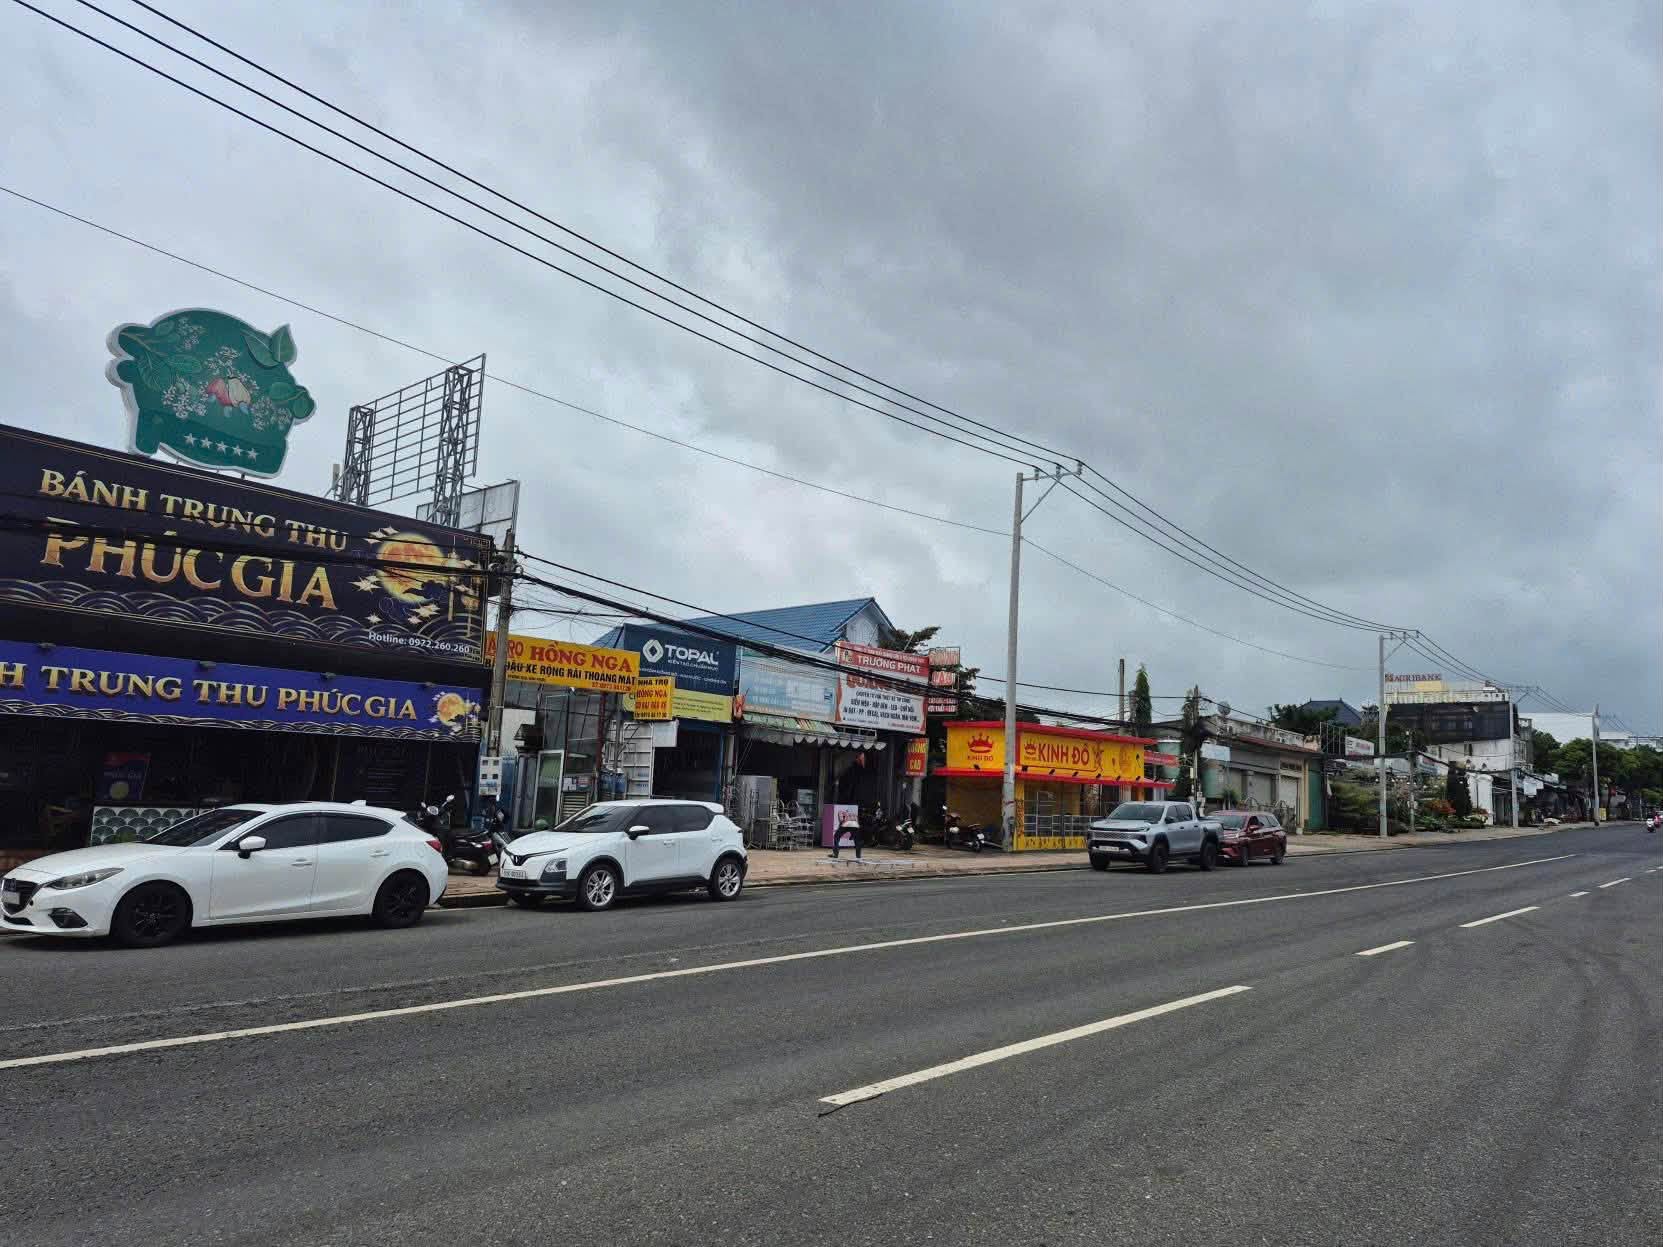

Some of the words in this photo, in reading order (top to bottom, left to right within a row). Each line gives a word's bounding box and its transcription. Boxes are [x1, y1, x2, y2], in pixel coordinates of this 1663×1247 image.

[39, 468, 150, 512] BÁNH
[160, 493, 276, 537] TRUNG
[284, 519, 349, 551] THU
[231, 554, 337, 610] GIA
[368, 631, 407, 645] Hotline:
[526, 663, 537, 674] XE
[530, 640, 587, 667] HỒNG
[591, 653, 633, 673] NGA
[665, 644, 719, 666] TOPAL
[41, 665, 183, 700] TRUNG
[193, 679, 269, 708] THU
[277, 687, 361, 716] PHÚC
[364, 695, 417, 720] GIA
[1038, 743, 1069, 765] KINH
[1071, 743, 1090, 765] ĐÔ
